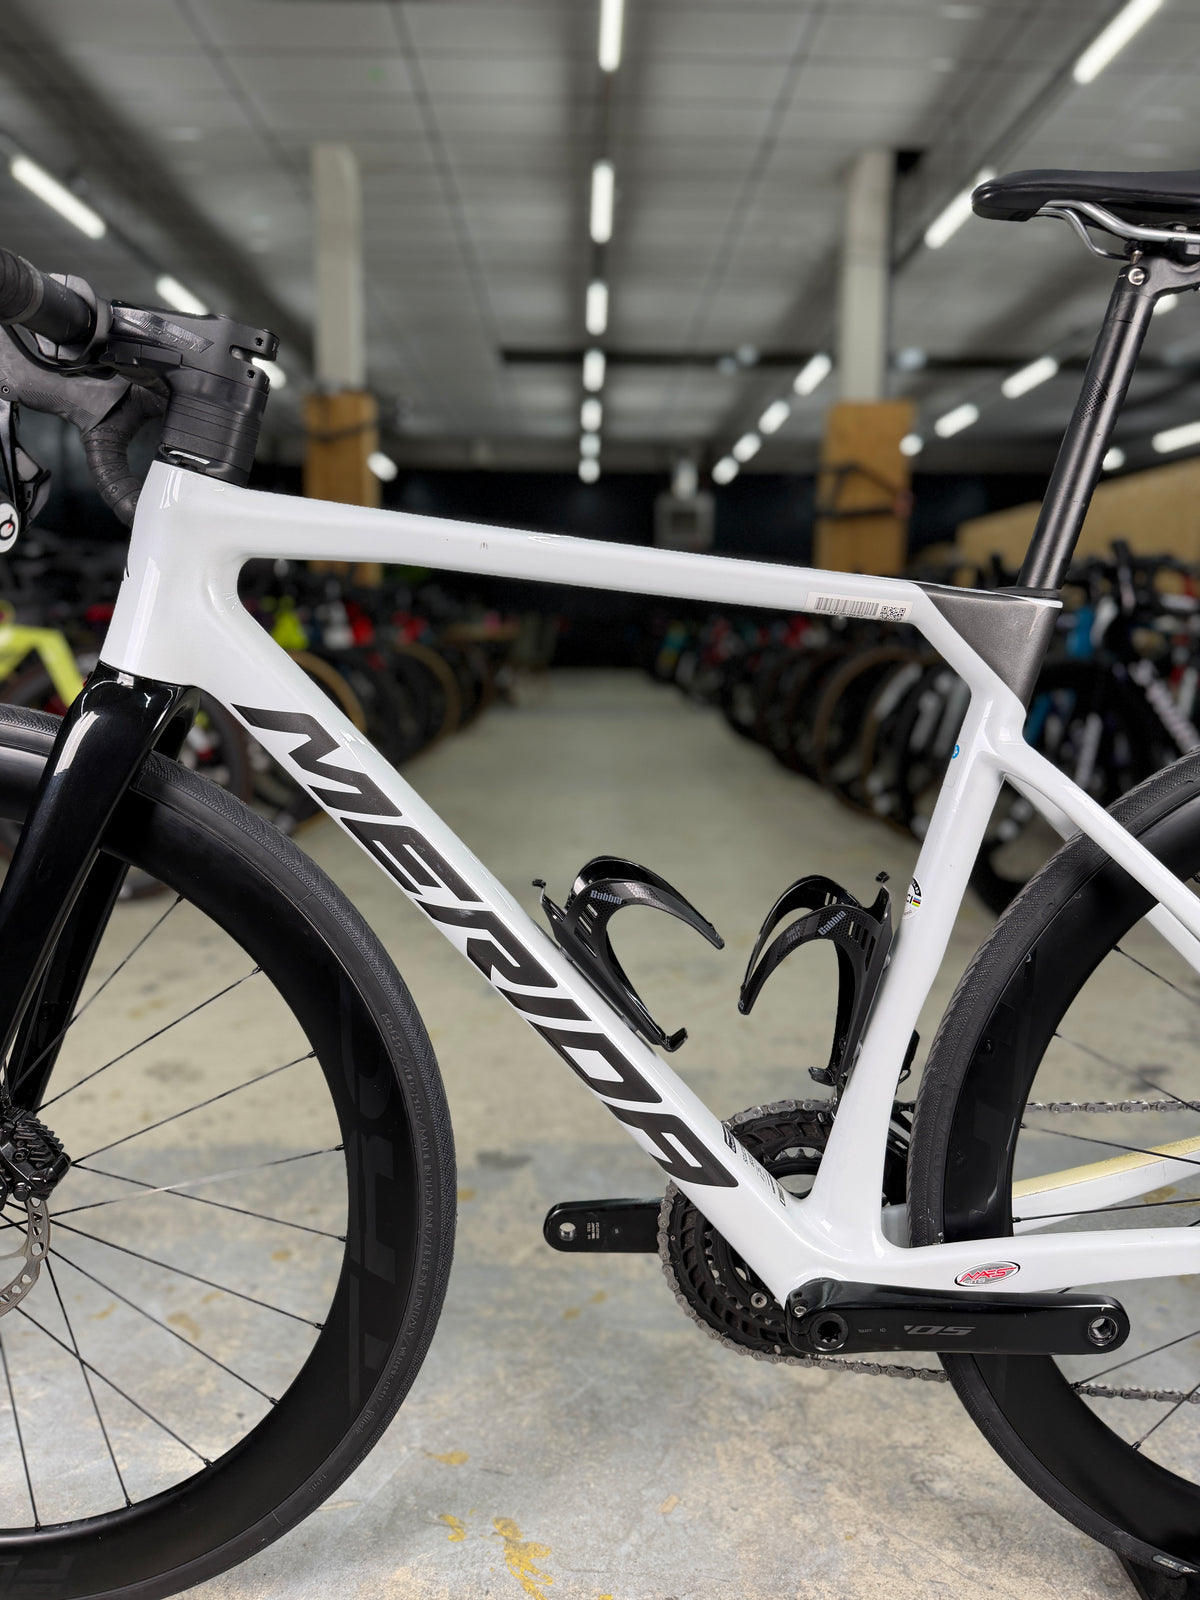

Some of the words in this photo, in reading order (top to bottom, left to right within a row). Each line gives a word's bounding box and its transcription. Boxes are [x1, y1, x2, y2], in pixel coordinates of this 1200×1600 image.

[590, 889, 623, 905] Gabbia
[817, 910, 847, 936] Gabbia
[230, 703, 739, 1188] MERIDA
